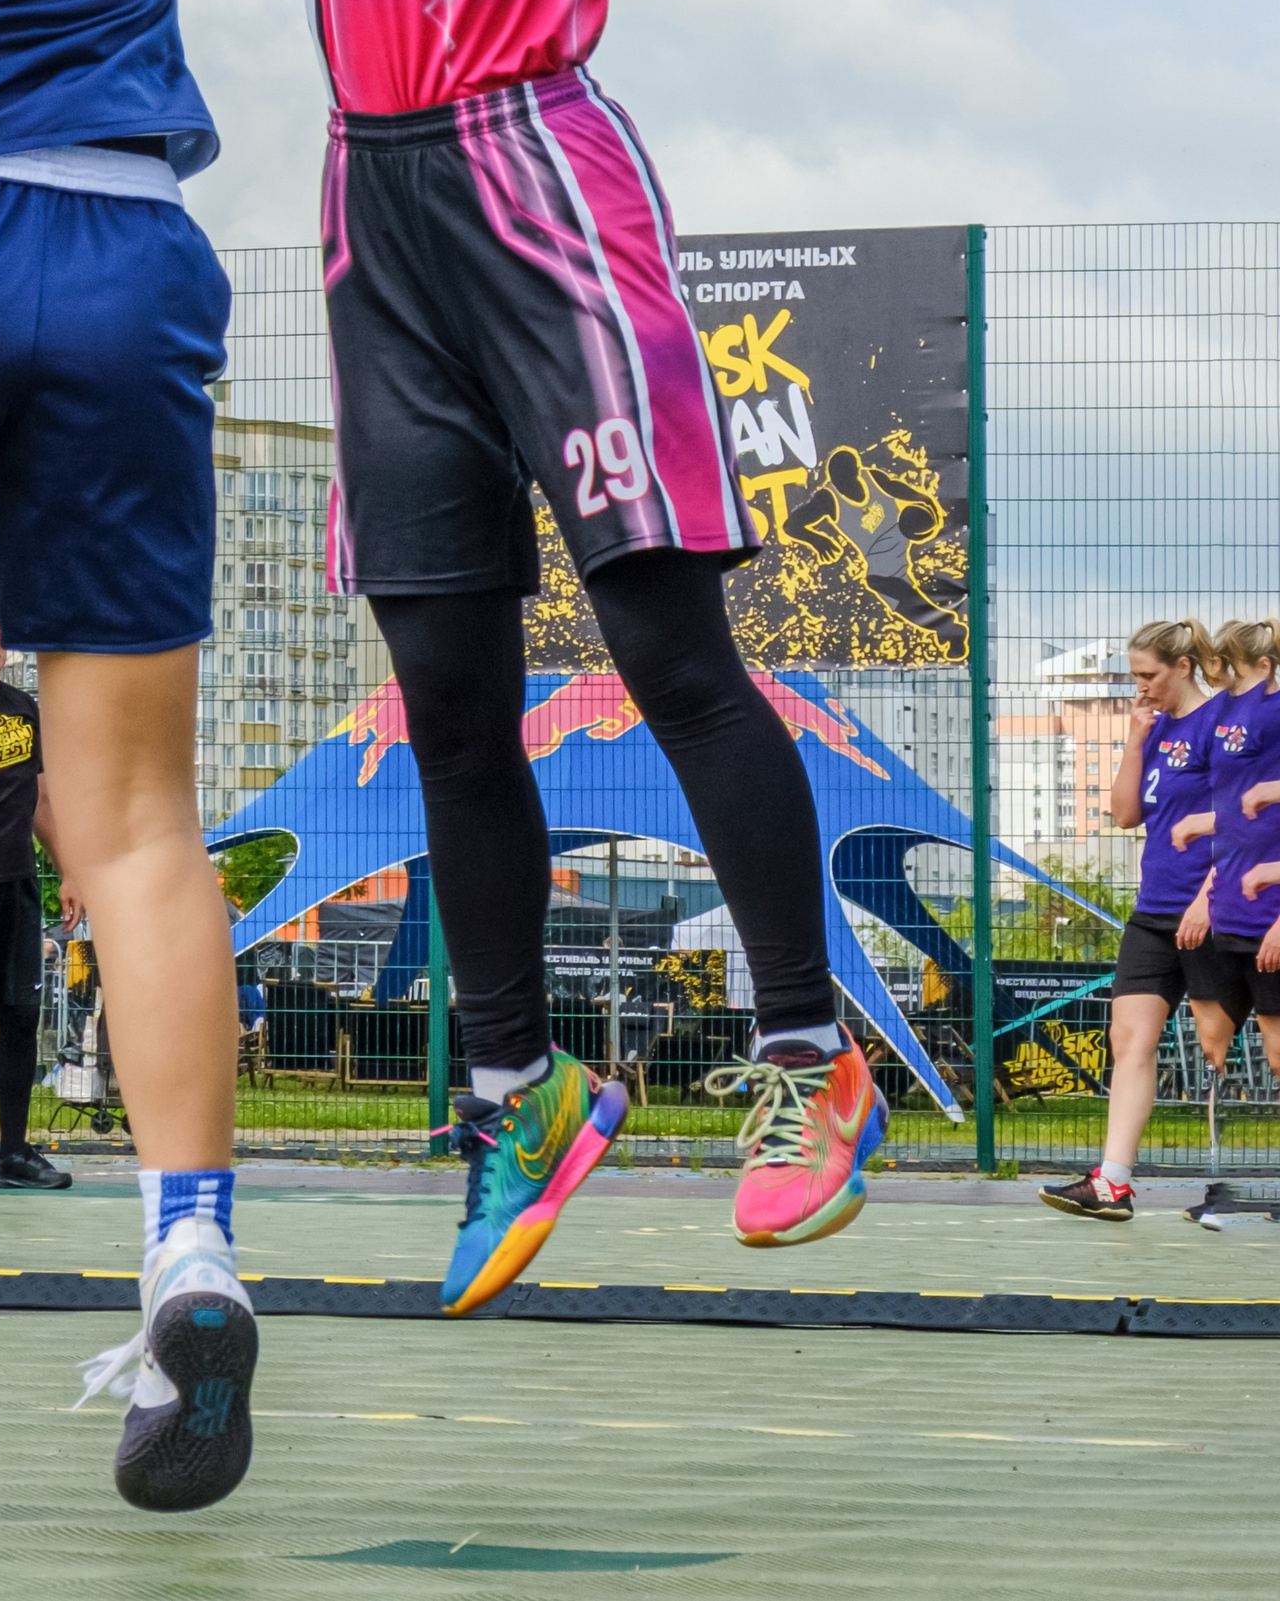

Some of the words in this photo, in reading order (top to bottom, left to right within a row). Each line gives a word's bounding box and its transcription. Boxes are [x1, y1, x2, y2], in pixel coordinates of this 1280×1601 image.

[719, 245, 857, 270] УЛИЧНЫХ
[695, 280, 806, 303] СПОРТА
[563, 417, 651, 518] 29
[1143, 768, 1160, 804] 2
